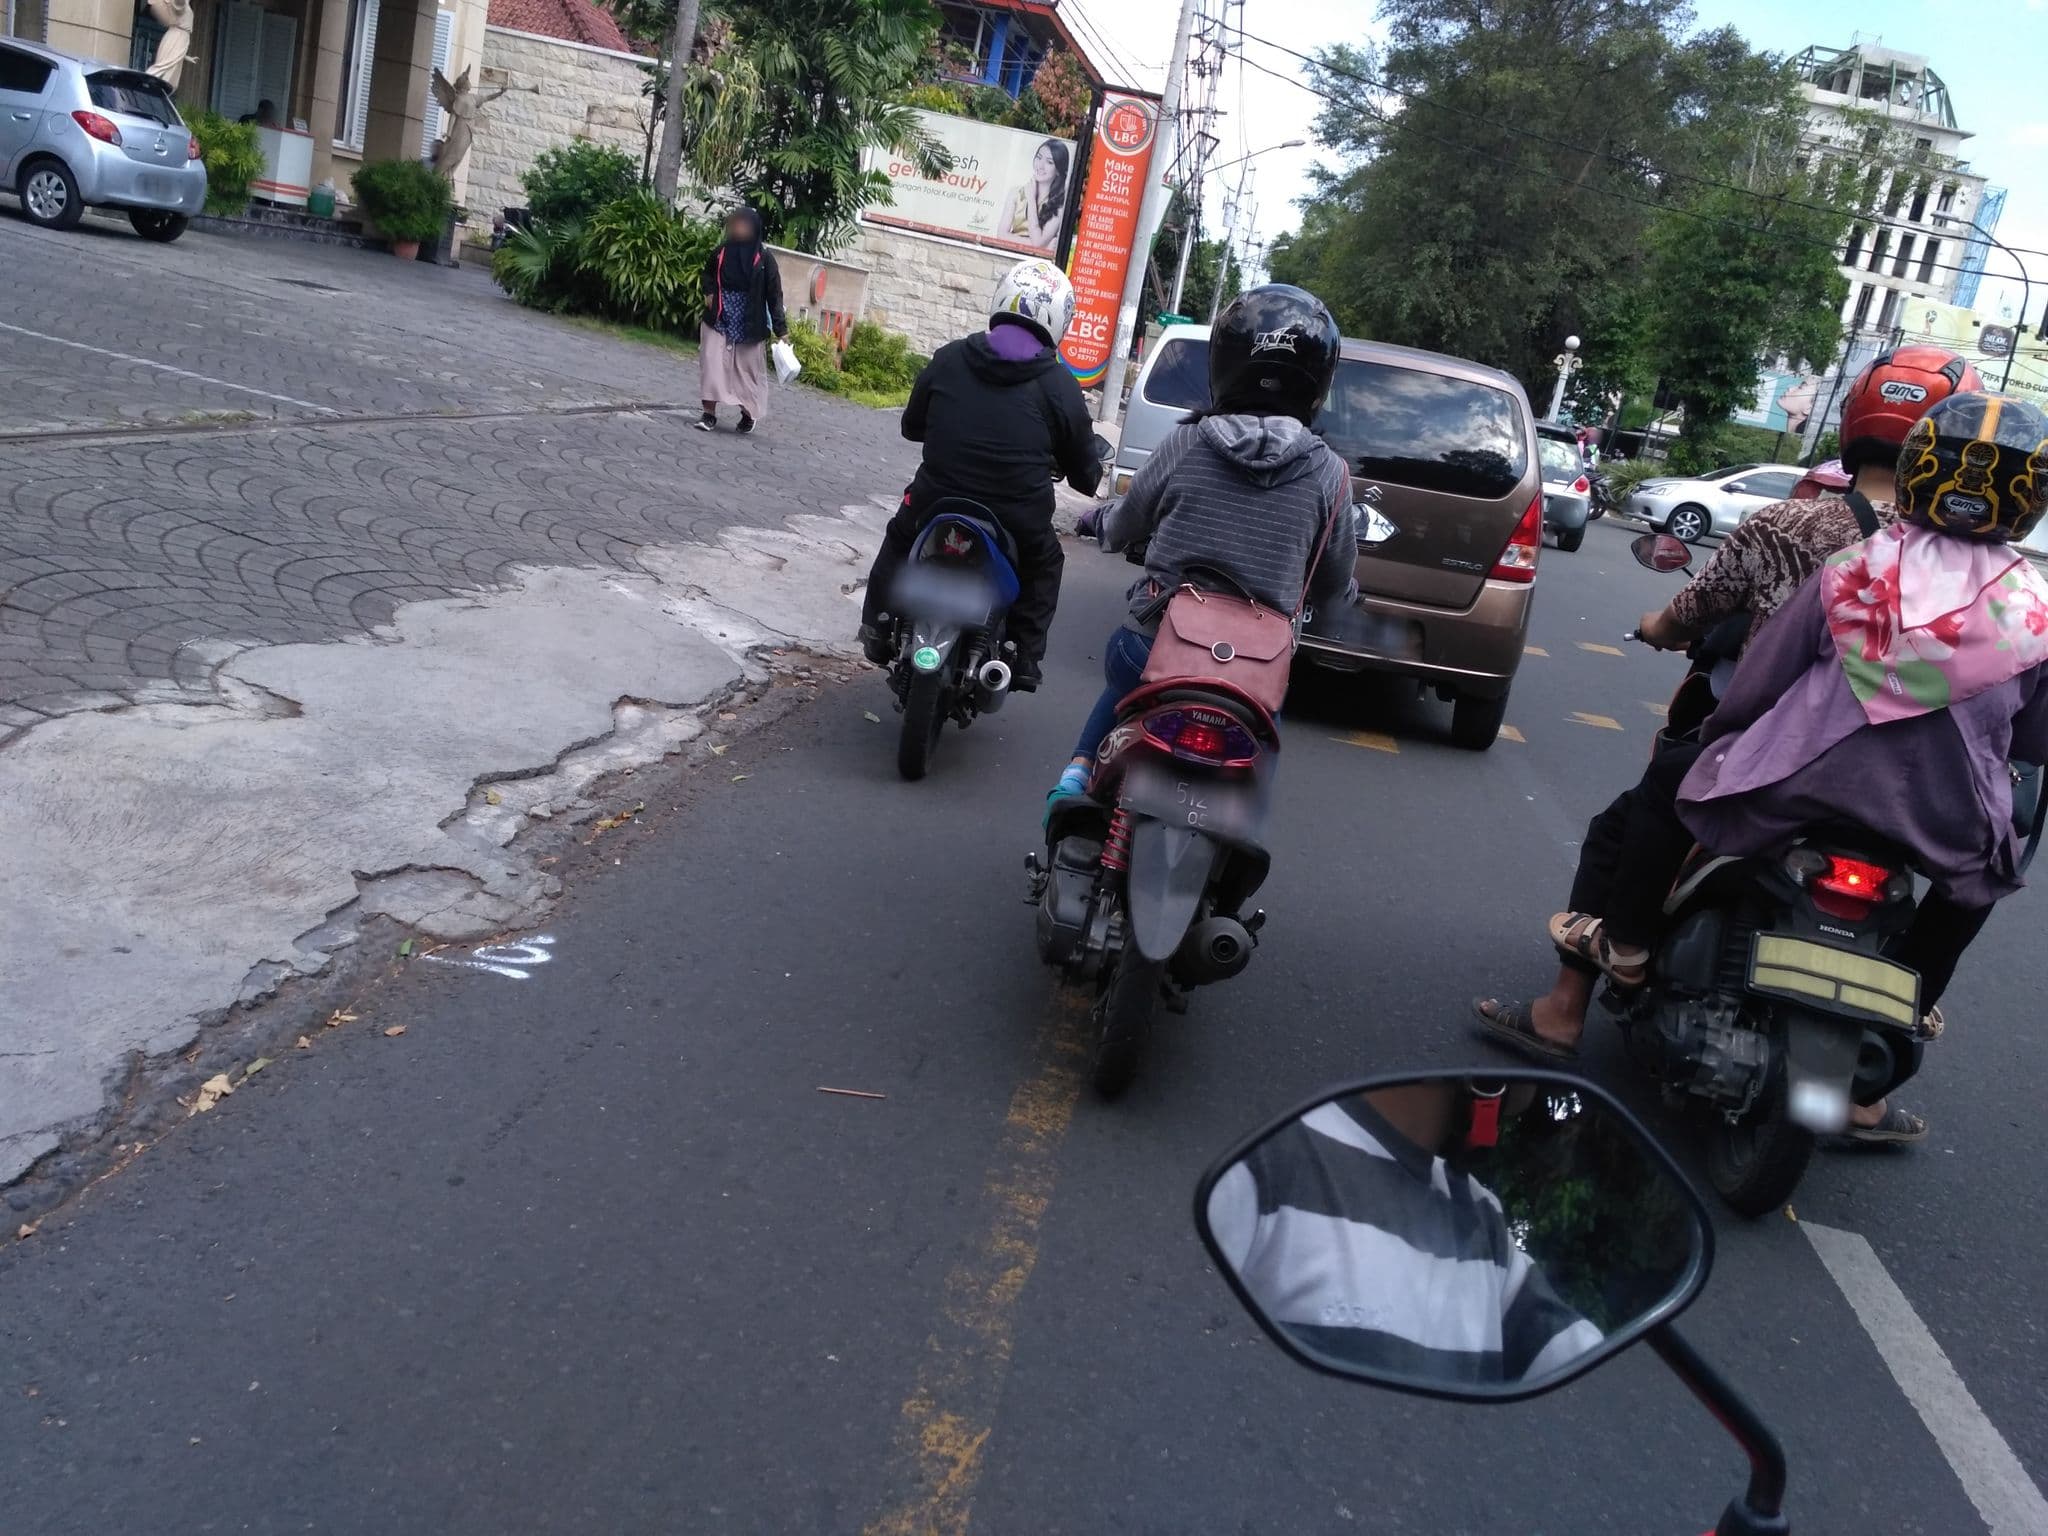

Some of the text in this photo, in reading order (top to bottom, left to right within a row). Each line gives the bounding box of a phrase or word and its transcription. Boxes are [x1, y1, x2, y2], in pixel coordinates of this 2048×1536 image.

[1113, 131, 1139, 145] LBC
[1104, 158, 1135, 173] Make
[1104, 169, 1133, 183] Your
[1102, 180, 1130, 196] Skin
[1095, 192, 1130, 206] BEAUTIFUL
[1112, 207, 1129, 218] FACIAL
[1068, 319, 1108, 342] LBC
[1982, 371, 2000, 383] FIFA
[1884, 383, 1924, 400] BMC
[1950, 498, 1983, 512] BMC
[1442, 557, 1483, 571] ESTILO
[1192, 709, 1227, 726] YAMAHA
[1819, 923, 1855, 938] HONDA
